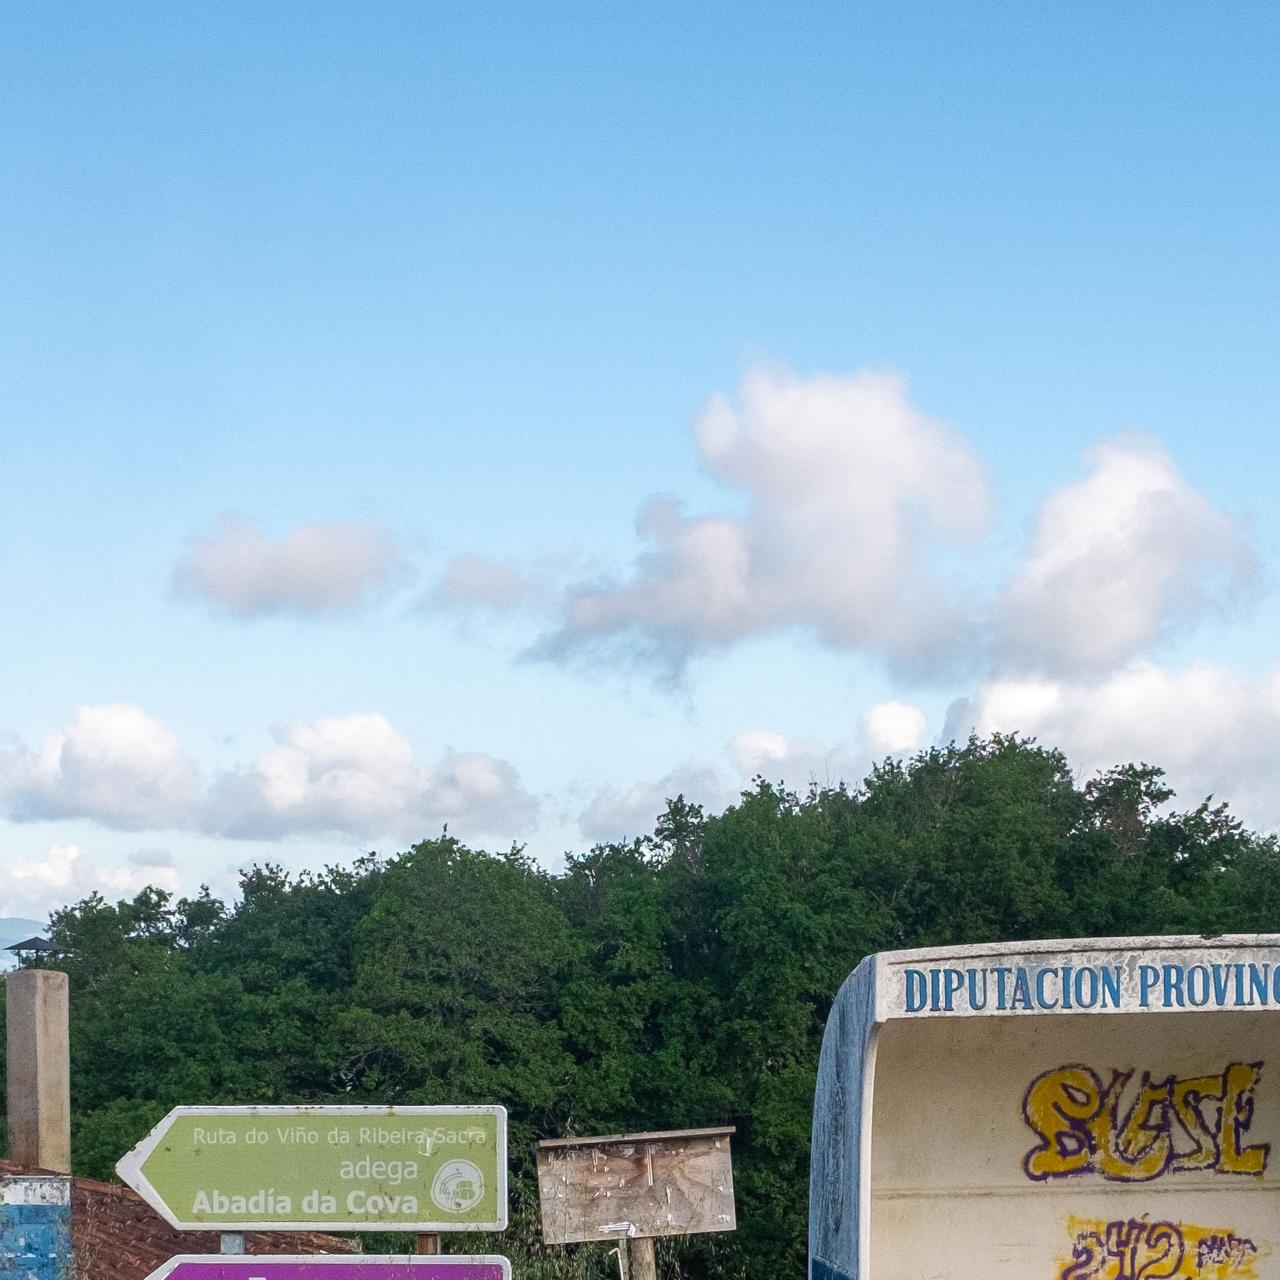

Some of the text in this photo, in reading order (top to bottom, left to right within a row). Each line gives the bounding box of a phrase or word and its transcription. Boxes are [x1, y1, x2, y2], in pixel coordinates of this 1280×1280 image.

[904, 965, 1121, 1013] DIPUTACION
[193, 1127, 487, 1145] Ruta do Viño da Ribeira Sacra
[340, 1155, 418, 1184] adega
[192, 1187, 418, 1214] Abadía da Cova
